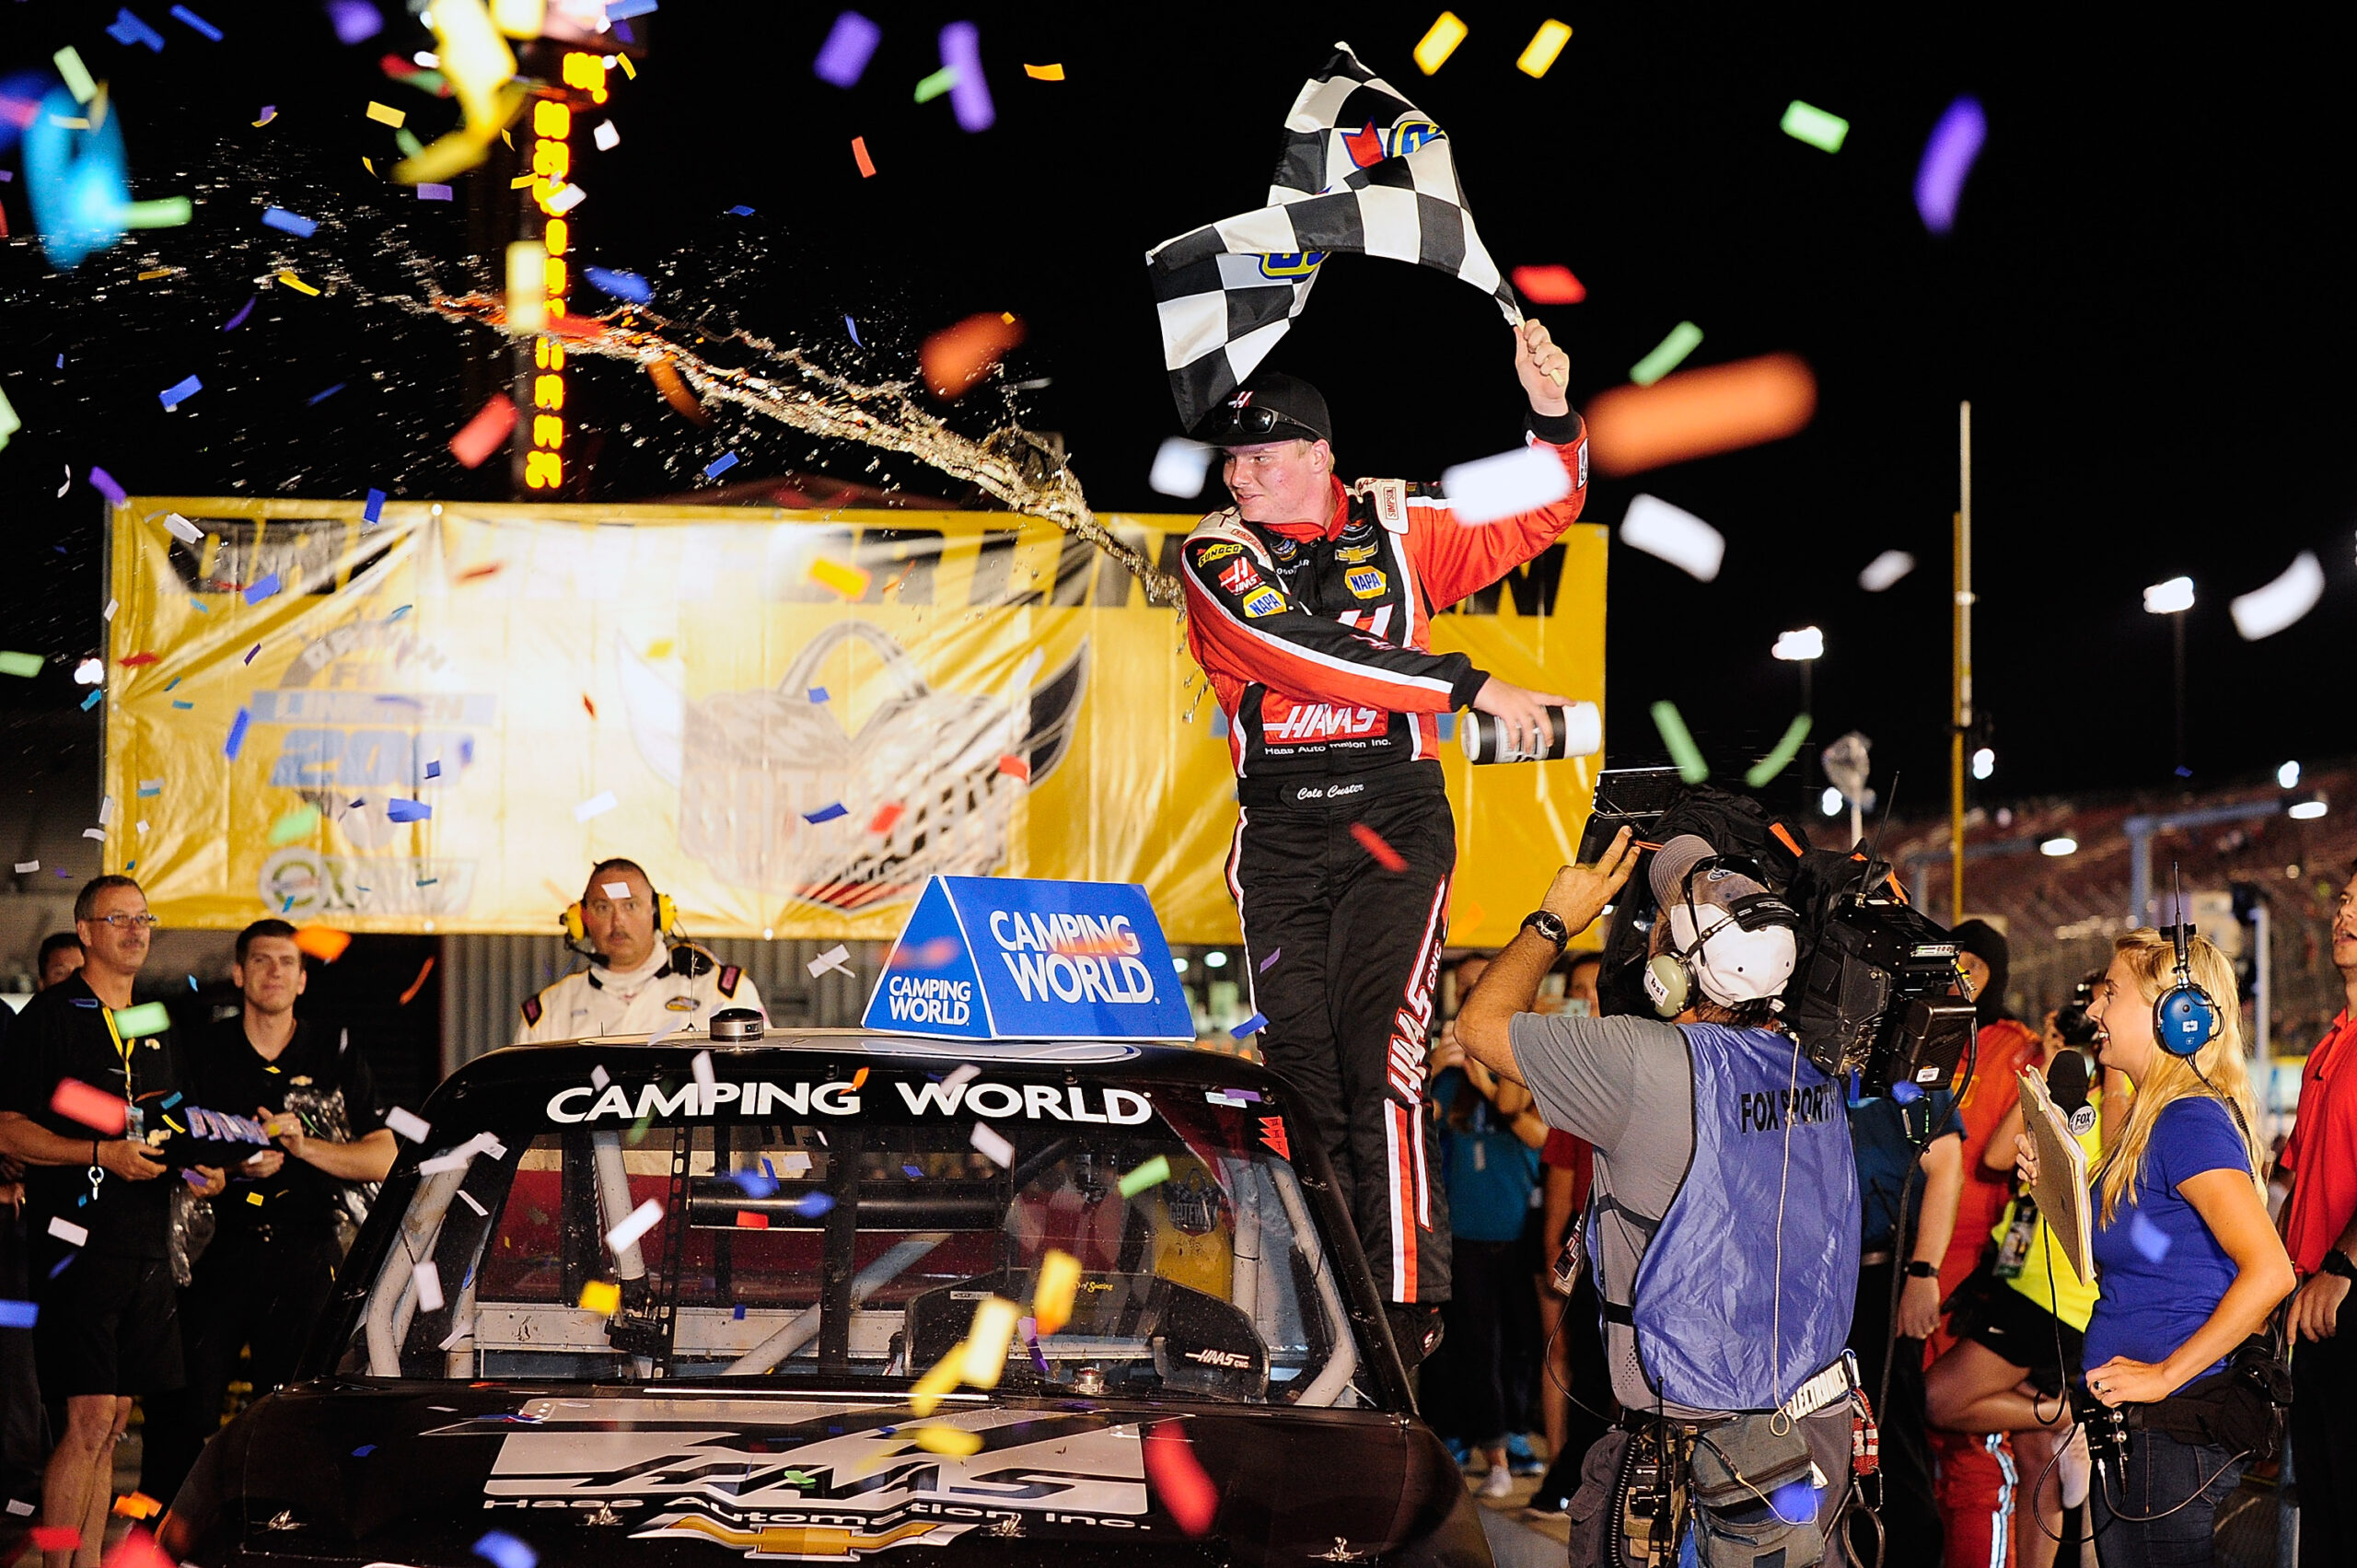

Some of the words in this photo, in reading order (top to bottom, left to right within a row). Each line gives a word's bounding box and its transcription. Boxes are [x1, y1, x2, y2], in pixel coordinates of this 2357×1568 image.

[1200, 545, 1240, 565] SUNOCO
[1349, 572, 1380, 592] NAPA
[1248, 592, 1282, 617] NAPA
[1262, 703, 1377, 739] HAAS
[1296, 787, 1323, 800] Cole
[1327, 784, 1364, 798] Custer
[989, 910, 1142, 956] CAMPING
[888, 976, 971, 1002] CAMPING
[1000, 952, 1155, 1005] WORLD
[888, 995, 970, 1027] WORLD
[546, 1081, 862, 1124] CAMPING
[894, 1081, 1153, 1125] WORLD
[1740, 1090, 1780, 1134] FOX
[2074, 1111, 2093, 1126] FOX
[1184, 1349, 1250, 1366] HAAS
[482, 1497, 645, 1510] Haas
[663, 1496, 1023, 1526] Automation
[1045, 1512, 1152, 1530] Inc.
